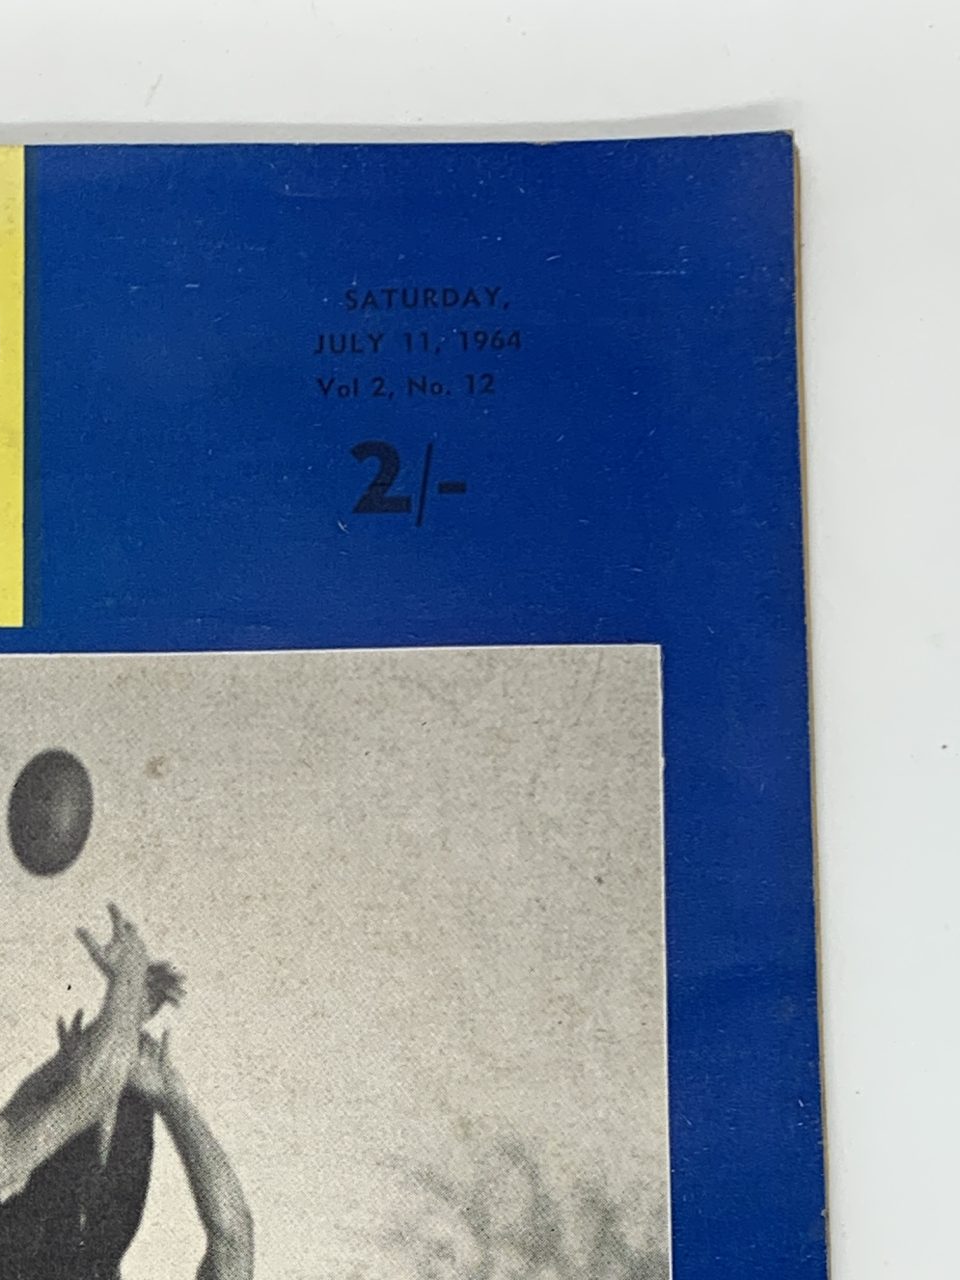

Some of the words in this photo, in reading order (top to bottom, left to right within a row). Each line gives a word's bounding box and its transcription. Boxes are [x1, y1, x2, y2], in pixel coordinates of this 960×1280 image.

[344, 287, 510, 312] SATURDAY,
[314, 333, 385, 355] JULY
[403, 331, 442, 355] 11,
[459, 329, 522, 351] 1964
[316, 377, 359, 398] Vol
[371, 375, 395, 400] 2,
[406, 376, 451, 397] No.
[465, 373, 496, 395] 12
[351, 440, 468, 528] 2/-
